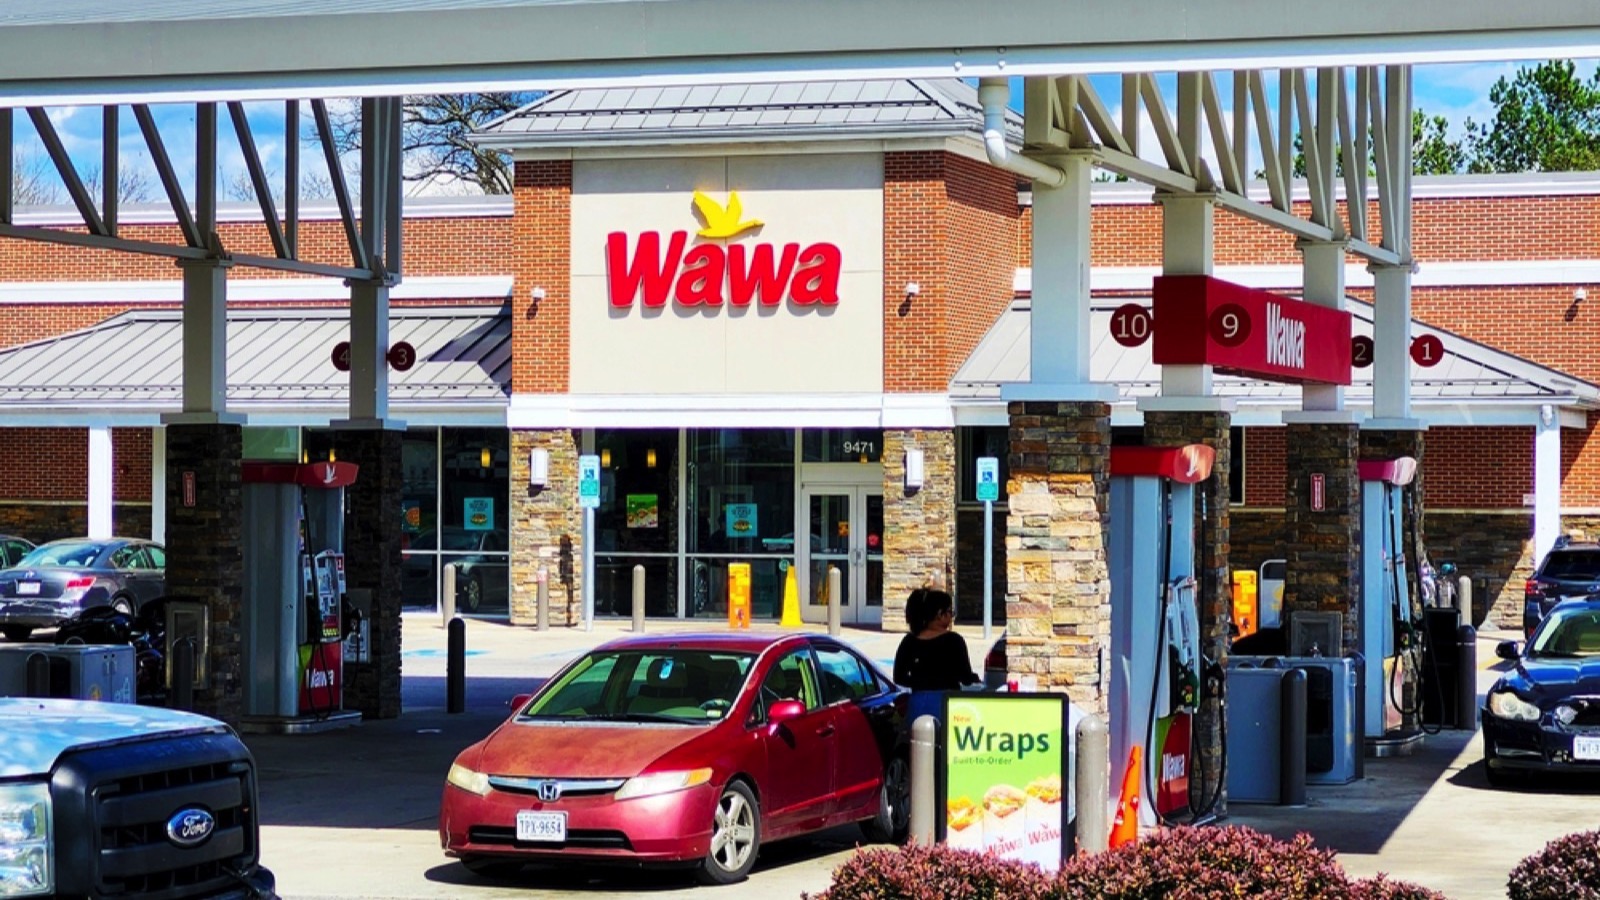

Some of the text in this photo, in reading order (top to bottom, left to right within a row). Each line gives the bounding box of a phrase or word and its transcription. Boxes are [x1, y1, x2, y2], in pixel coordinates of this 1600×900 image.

[607, 230, 842, 308] Wawa
[1117, 314, 1147, 338] 10
[1221, 314, 1239, 338] 9
[1266, 302, 1305, 369] Wawa
[397, 348, 408, 366] 3
[1354, 343, 1366, 361] 2
[1422, 343, 1432, 360] 1
[843, 440, 873, 453] 9471
[953, 725, 1050, 760] Wraps
[182, 814, 209, 837] Ford
